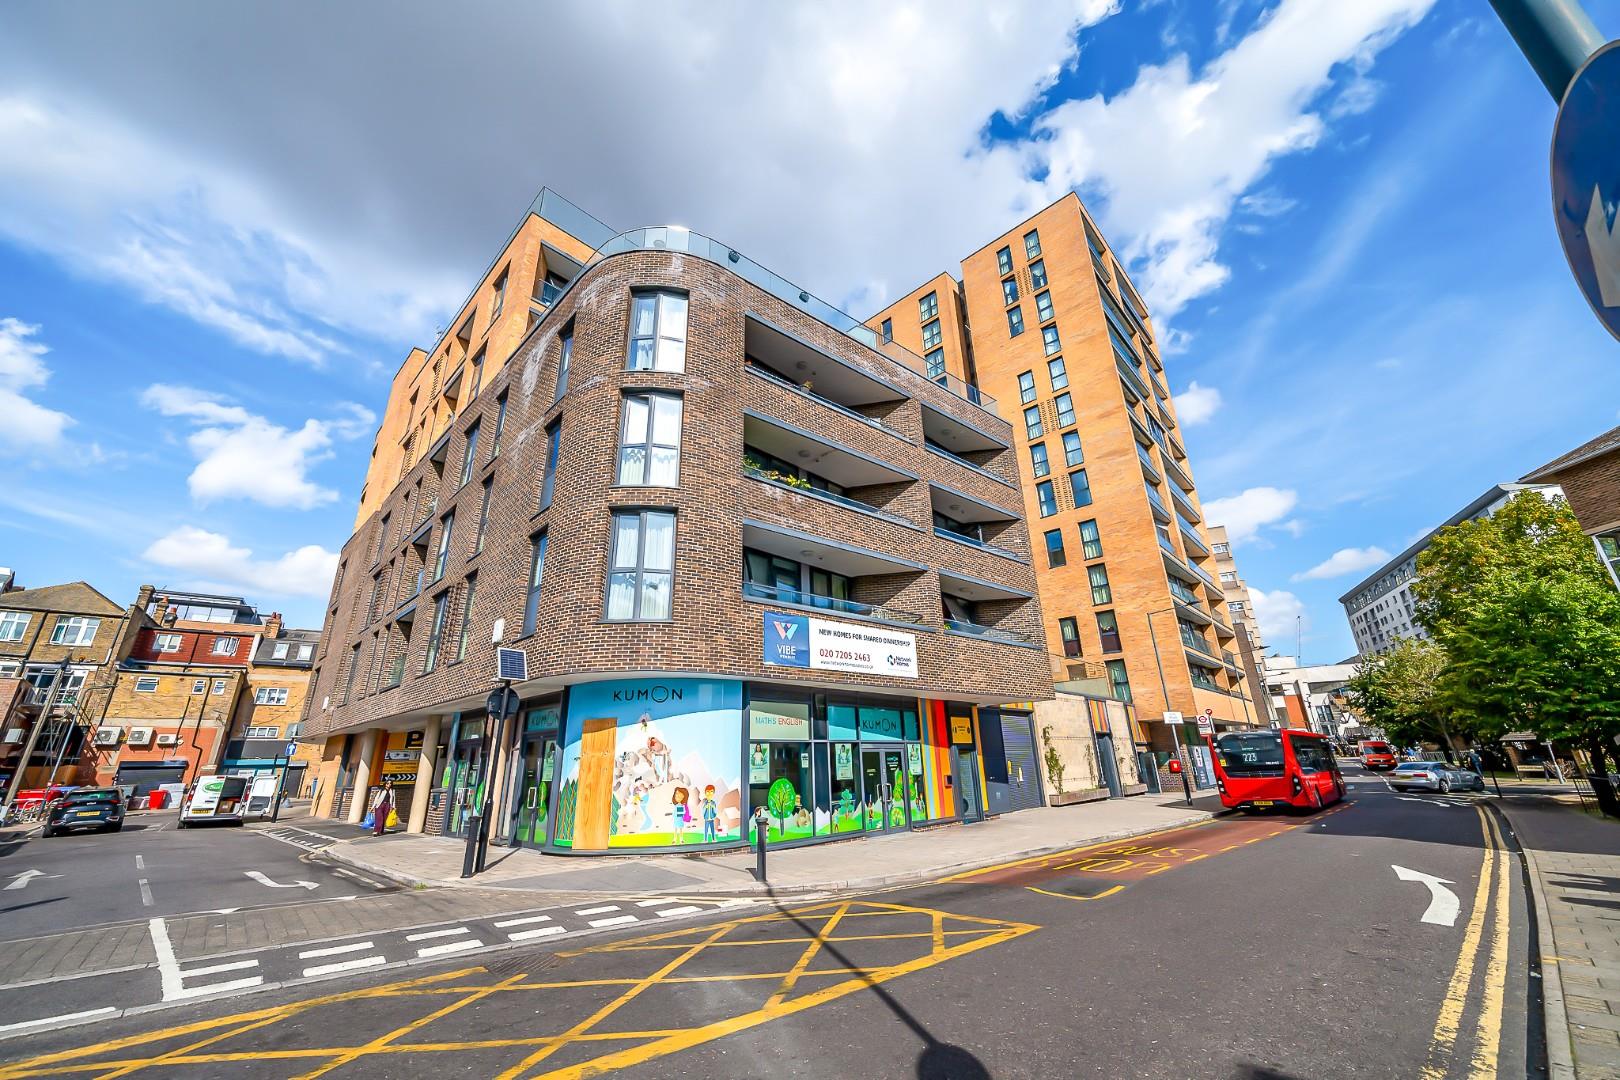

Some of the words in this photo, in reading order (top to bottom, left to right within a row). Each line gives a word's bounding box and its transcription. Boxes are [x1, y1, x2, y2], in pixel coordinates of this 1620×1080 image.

[818, 628, 832, 637] NEW
[833, 630, 852, 639] HOMES
[852, 633, 863, 641] FOR
[863, 635, 883, 644] SHARED
[776, 643, 797, 656] VIBE
[819, 648, 834, 658] 020
[835, 650, 853, 660] 7205
[854, 652, 871, 662] 2463
[613, 685, 683, 703] KUMON
[755, 716, 777, 725] MATHS
[778, 717, 803, 726] ENGLISH
[862, 718, 897, 731] KUMON
[1242, 752, 1258, 762] 223
[1092, 846, 1201, 858] BUS
